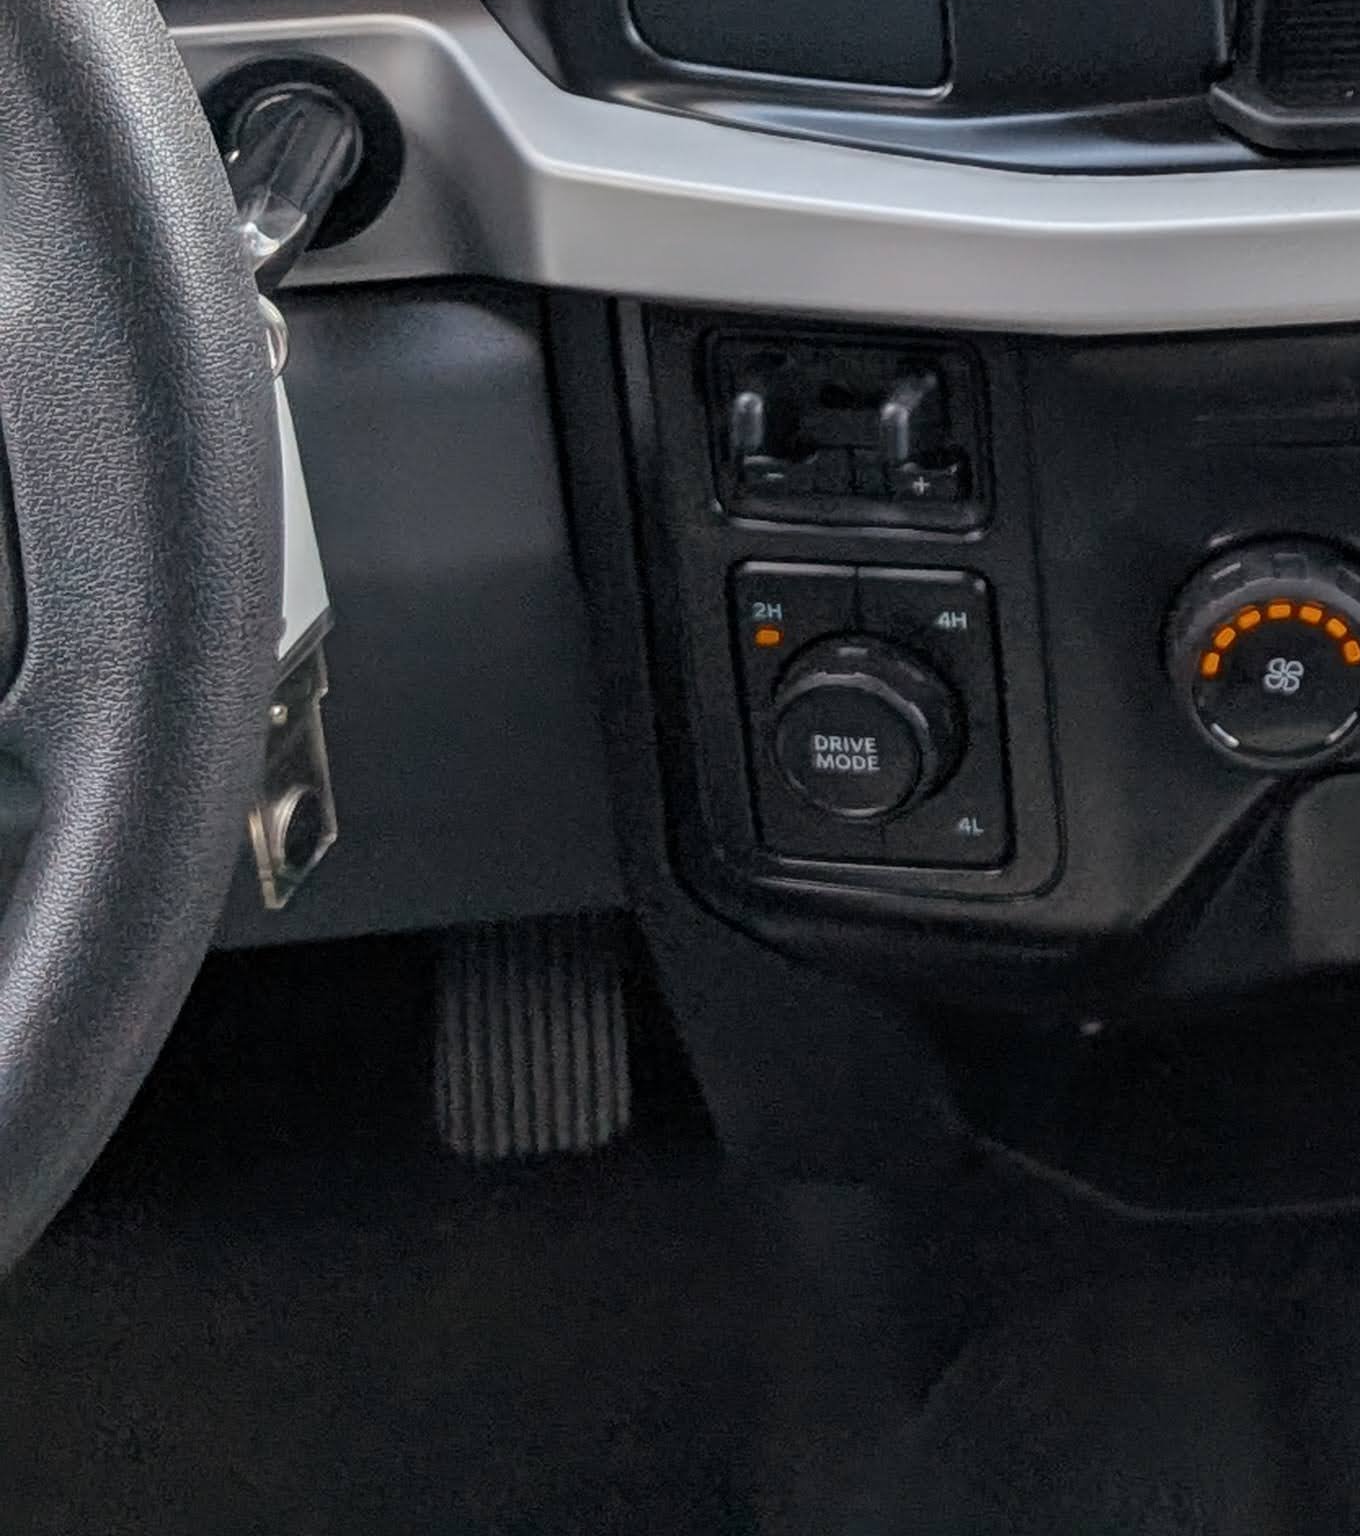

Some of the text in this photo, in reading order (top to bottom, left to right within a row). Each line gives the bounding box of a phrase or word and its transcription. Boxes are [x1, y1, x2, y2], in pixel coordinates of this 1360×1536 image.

[753, 601, 782, 619] 2H
[938, 611, 968, 629] 4H
[812, 734, 877, 754] DRIVE
[814, 752, 880, 772] MODE
[959, 817, 985, 835] 4L
